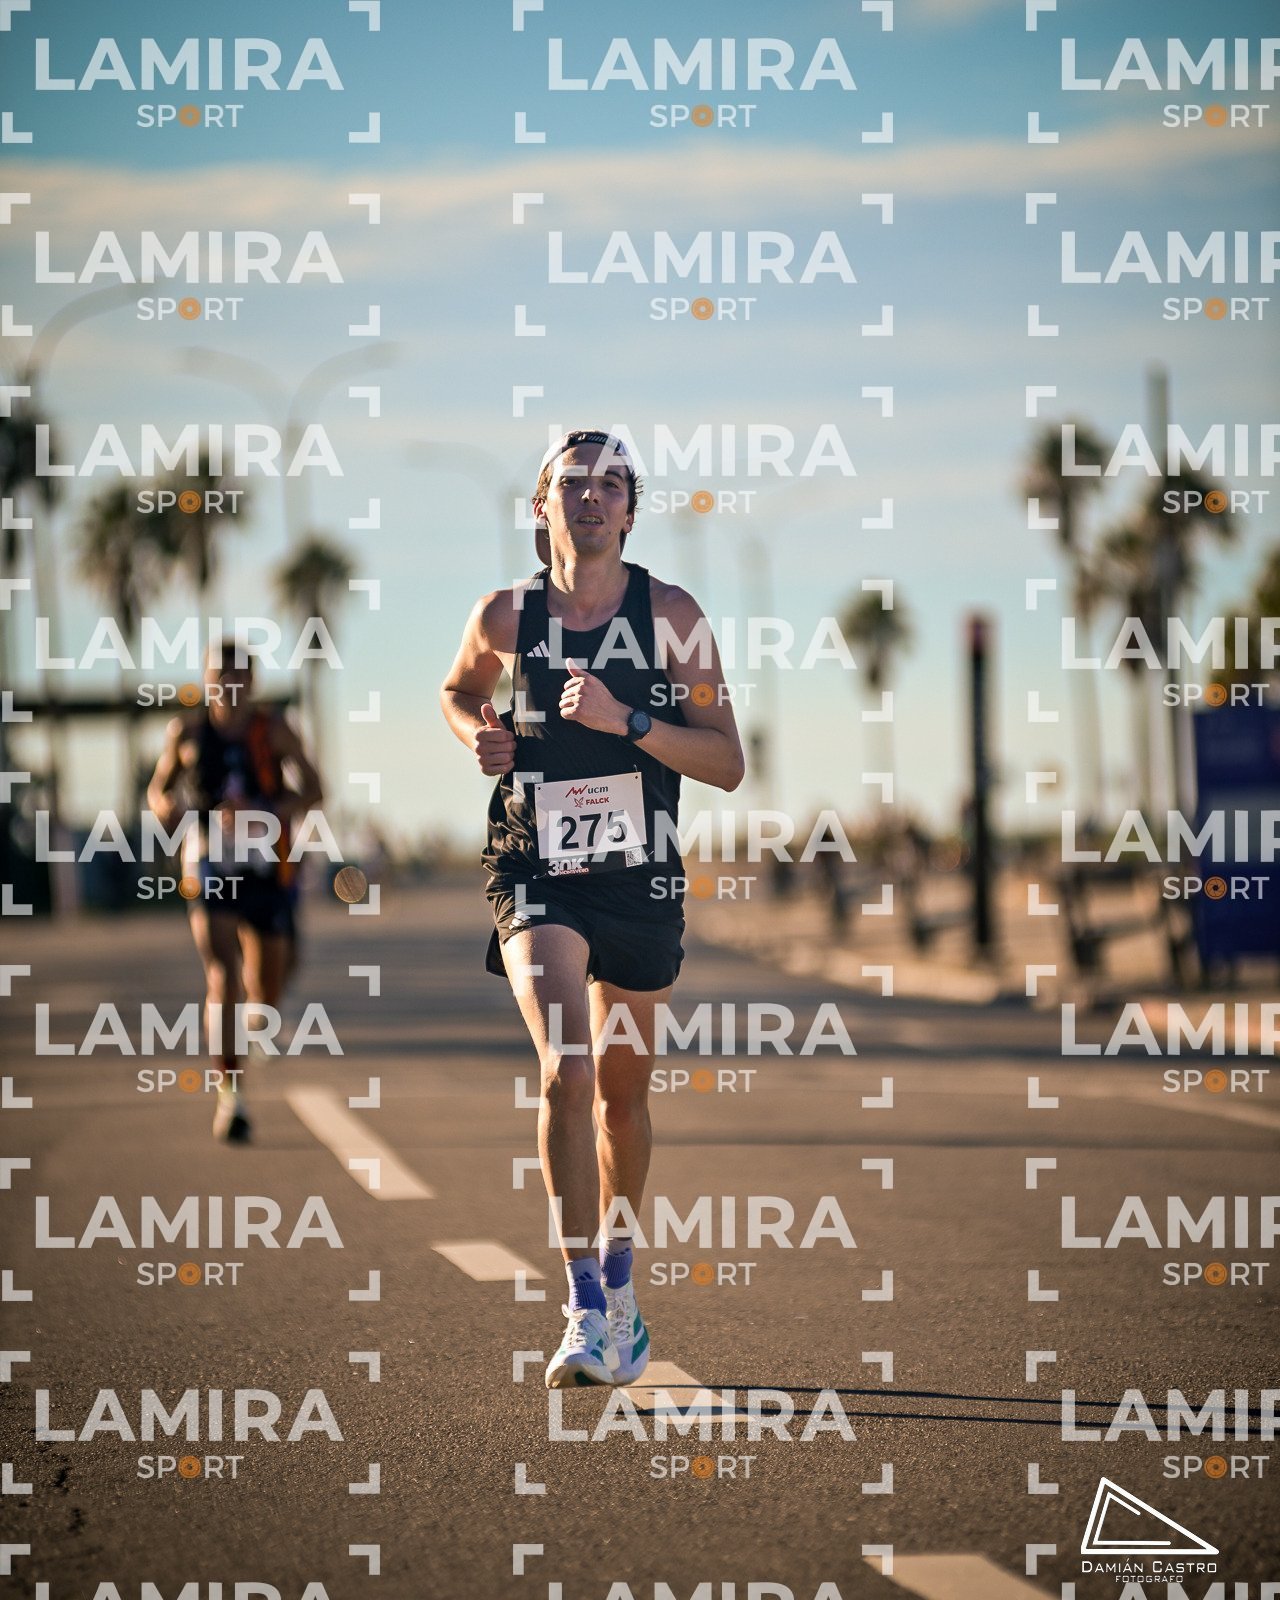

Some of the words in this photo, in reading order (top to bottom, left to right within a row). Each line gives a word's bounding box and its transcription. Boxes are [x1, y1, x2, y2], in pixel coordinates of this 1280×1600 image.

[588, 786, 608, 794] ucm
[586, 797, 609, 805] FALCK
[557, 810, 627, 850] 275
